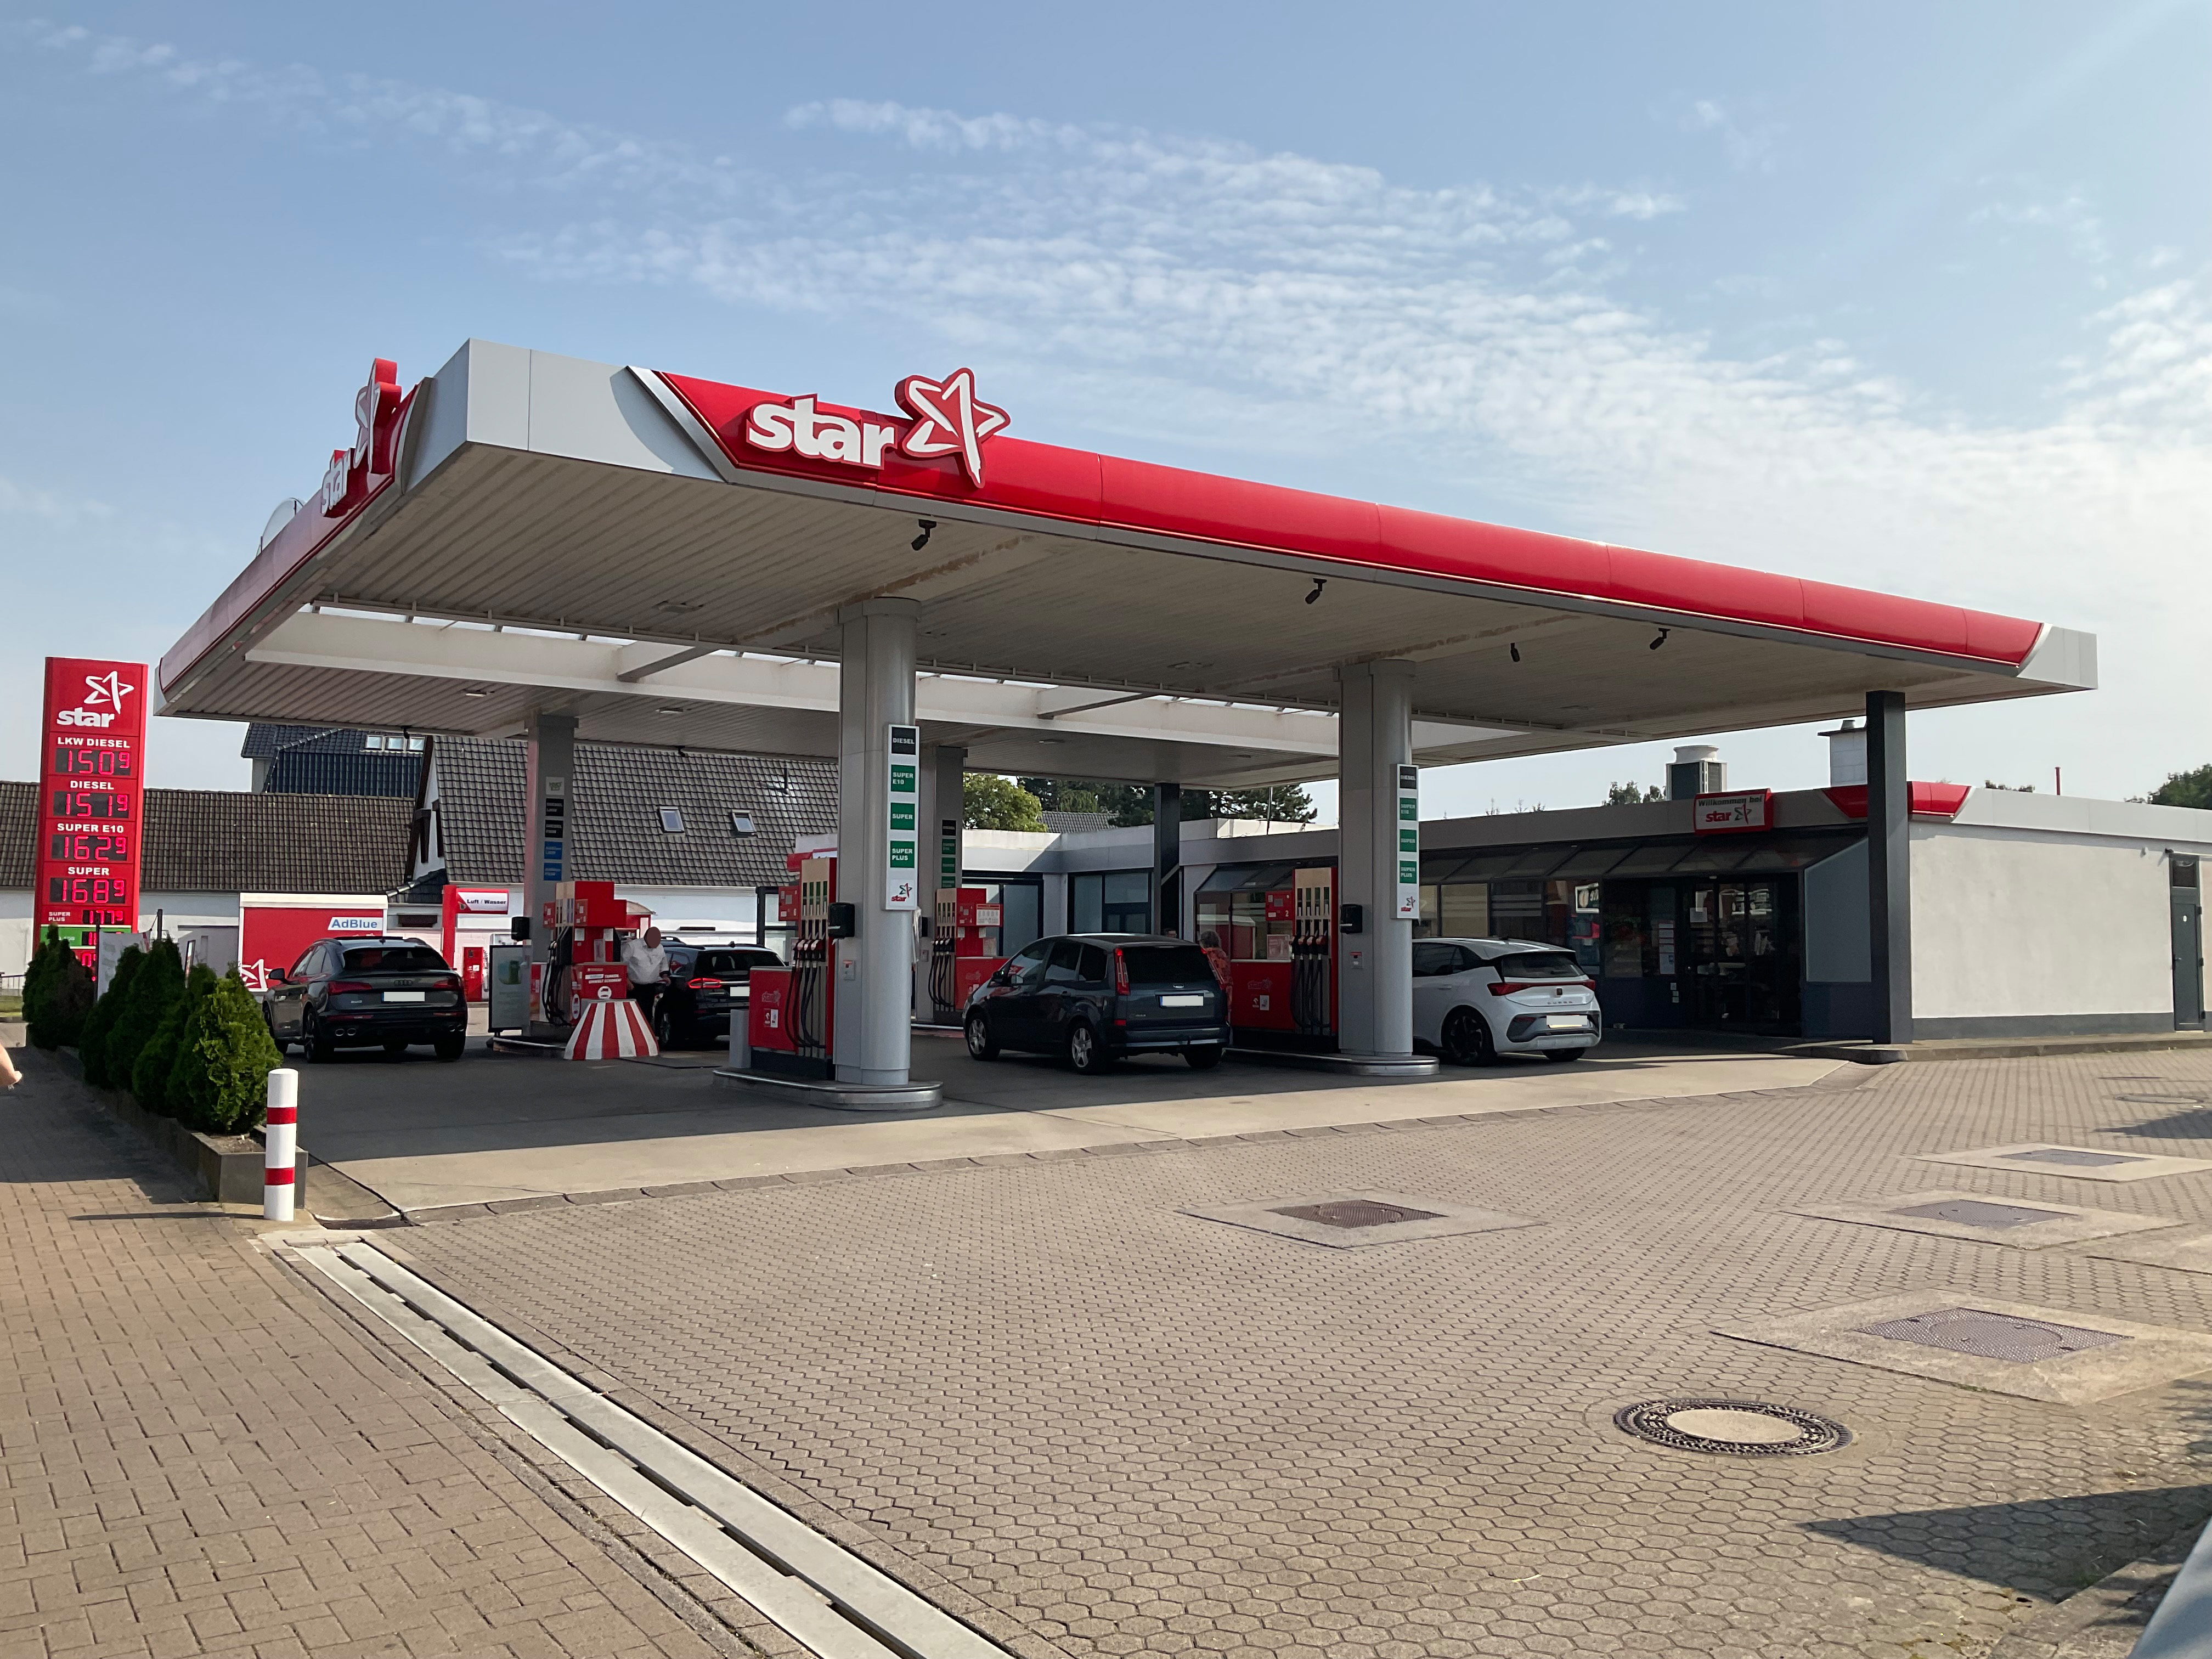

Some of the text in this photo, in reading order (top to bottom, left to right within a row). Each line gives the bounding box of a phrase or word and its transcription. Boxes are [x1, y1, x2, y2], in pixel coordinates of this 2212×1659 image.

[749, 397, 895, 467] star
[57, 707, 115, 728] star
[57, 737, 130, 748] LKW DIESEL
[70, 780, 115, 790] DIESEL
[1699, 798, 1747, 806] Willkommen
[1706, 811, 1731, 822] star
[57, 823, 124, 833] SUPER E10
[68, 867, 110, 876] SUPER
[331, 919, 377, 928] AdBlue
